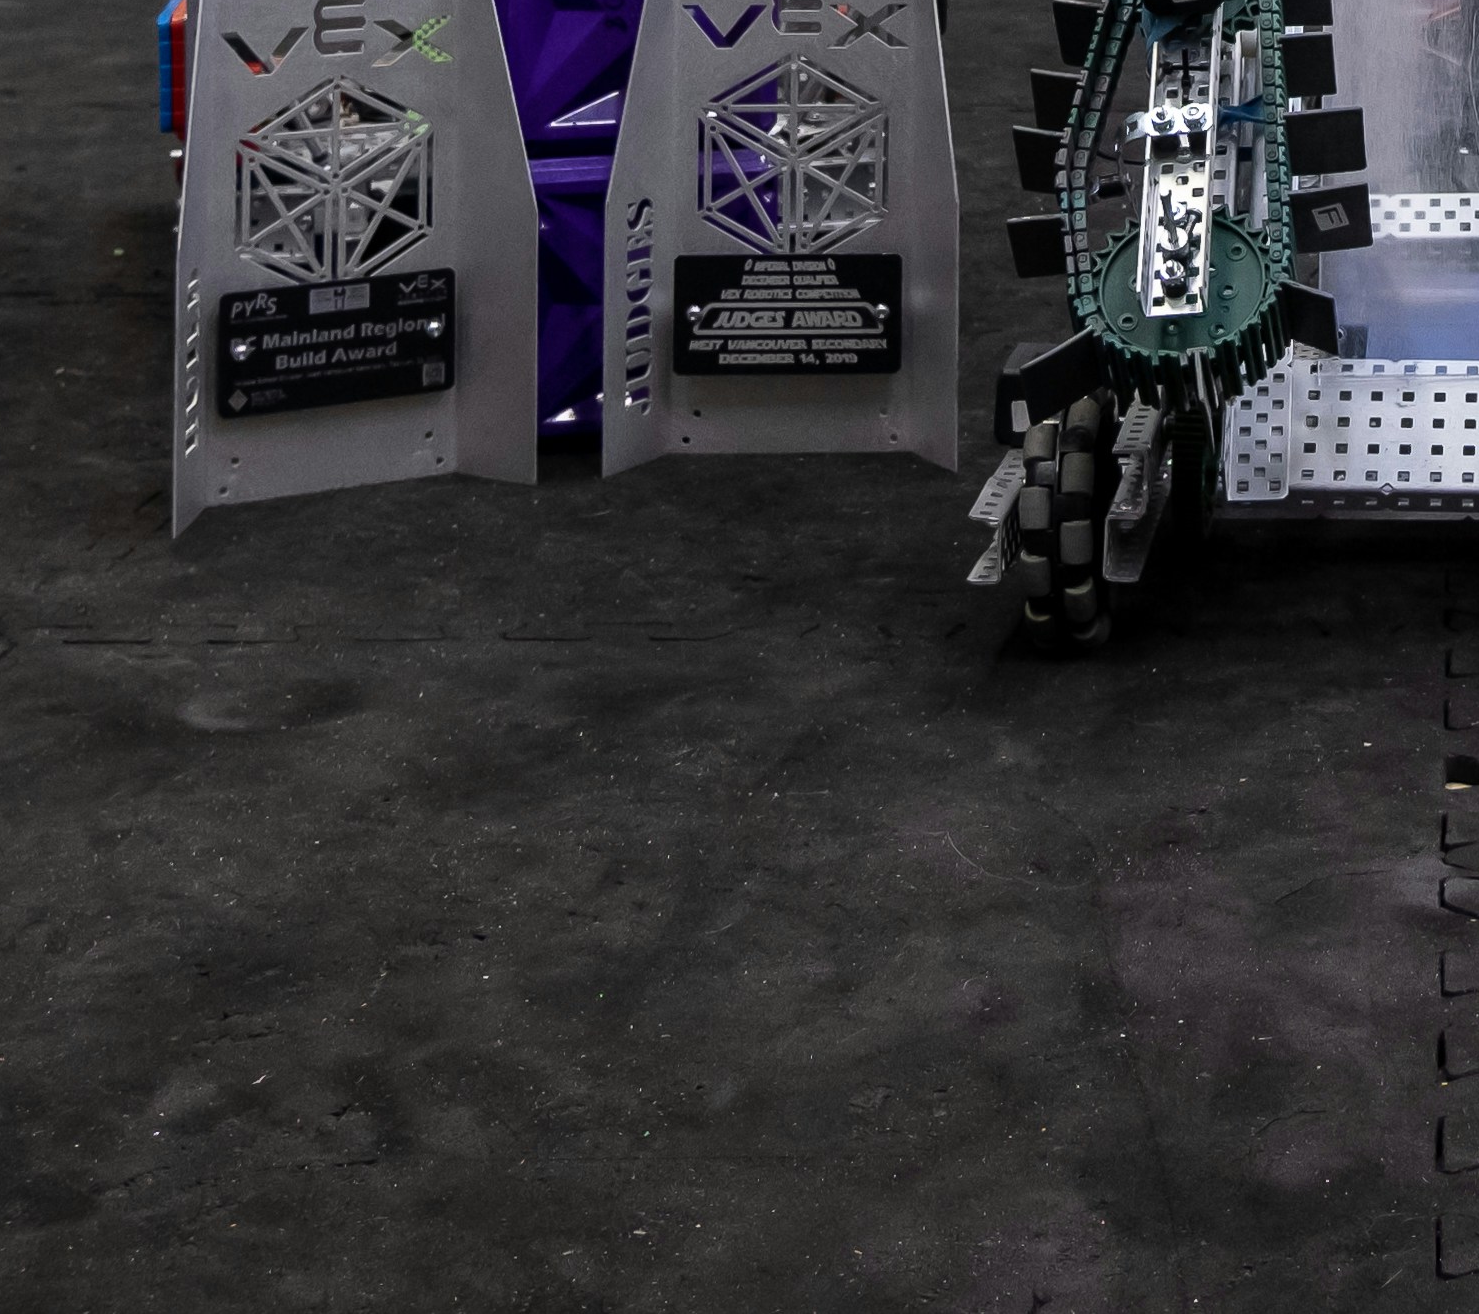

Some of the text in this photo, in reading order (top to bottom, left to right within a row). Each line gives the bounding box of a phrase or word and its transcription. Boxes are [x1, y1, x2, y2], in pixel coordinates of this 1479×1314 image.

[399, 274, 447, 293] VEX
[721, 289, 743, 300] VEX
[744, 289, 793, 299] ROBOTICS
[231, 292, 278, 319] PYRS
[625, 197, 654, 417] JUDGES
[713, 311, 863, 328] JUDGES AWARD
[230, 313, 446, 356] C Mainland Regionl
[728, 339, 808, 350] VANCOUVER
[276, 342, 397, 370] Build Award
[719, 353, 795, 364] DECEMBER
